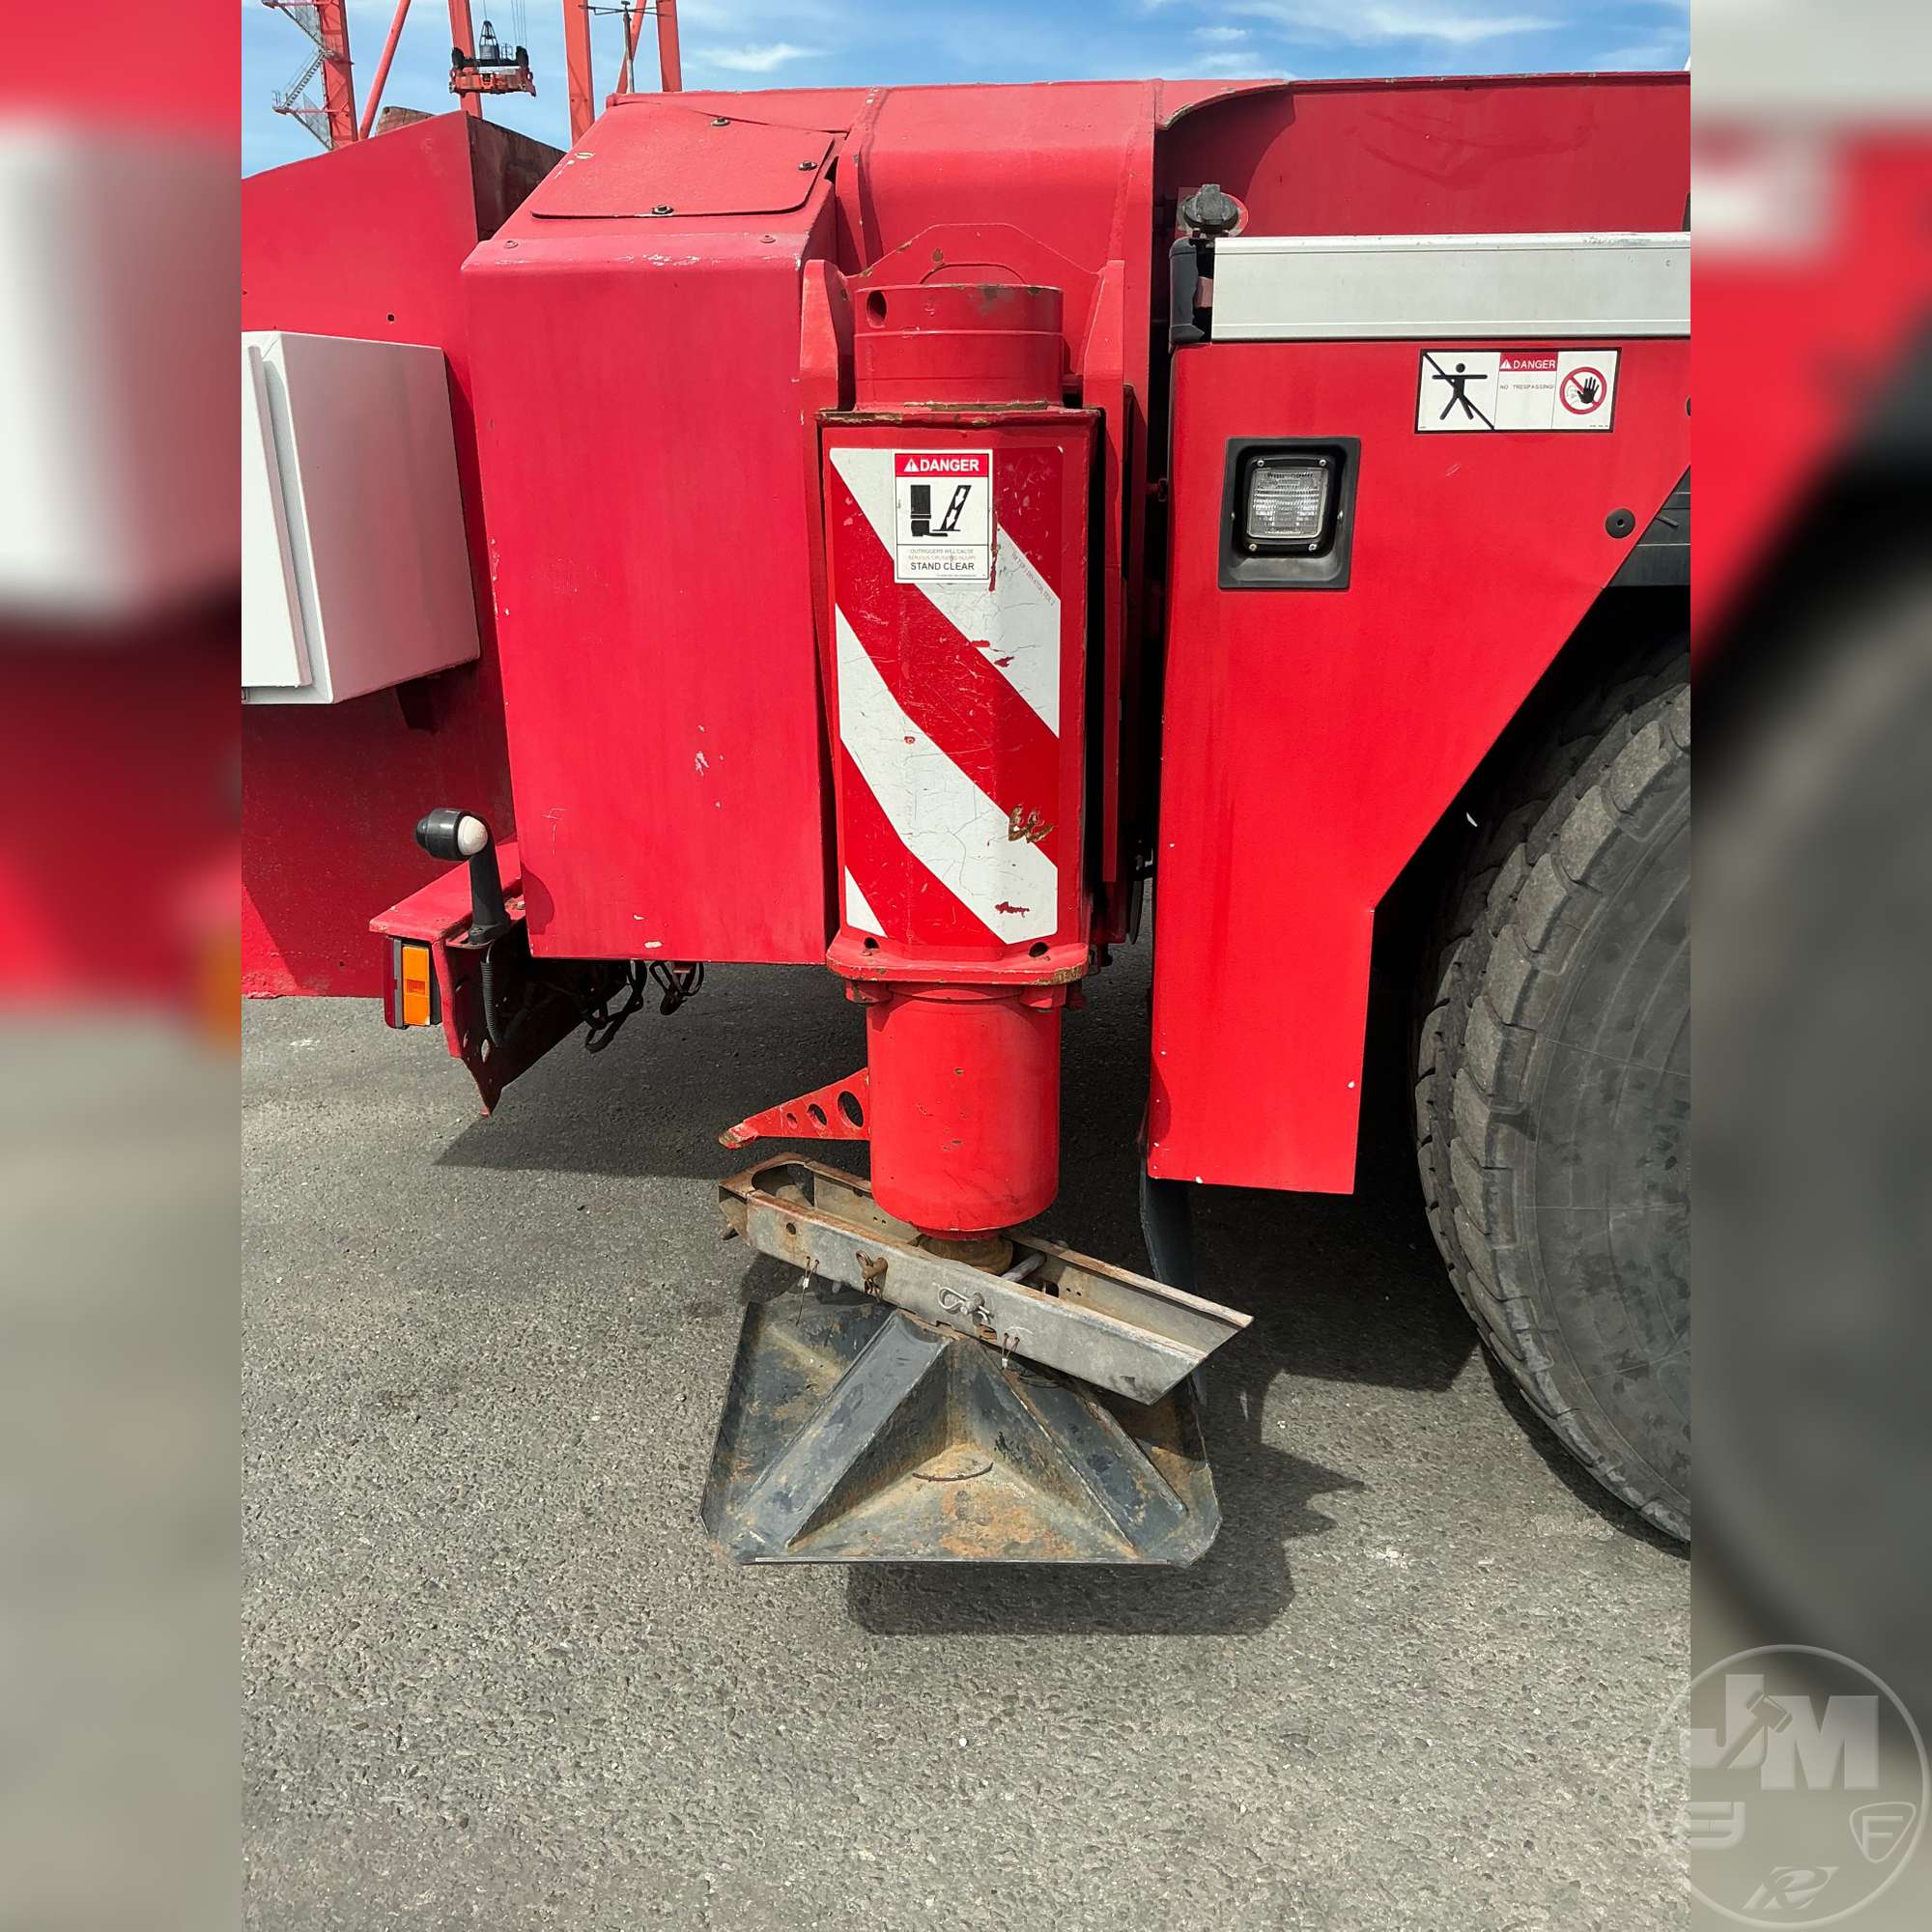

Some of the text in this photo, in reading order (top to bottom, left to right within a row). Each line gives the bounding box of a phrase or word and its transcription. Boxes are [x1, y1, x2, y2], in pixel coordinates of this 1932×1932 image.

[1514, 359, 1556, 369] DANGER
[920, 459, 980, 472] DANGER
[910, 562, 975, 571] STAND CLEAR
